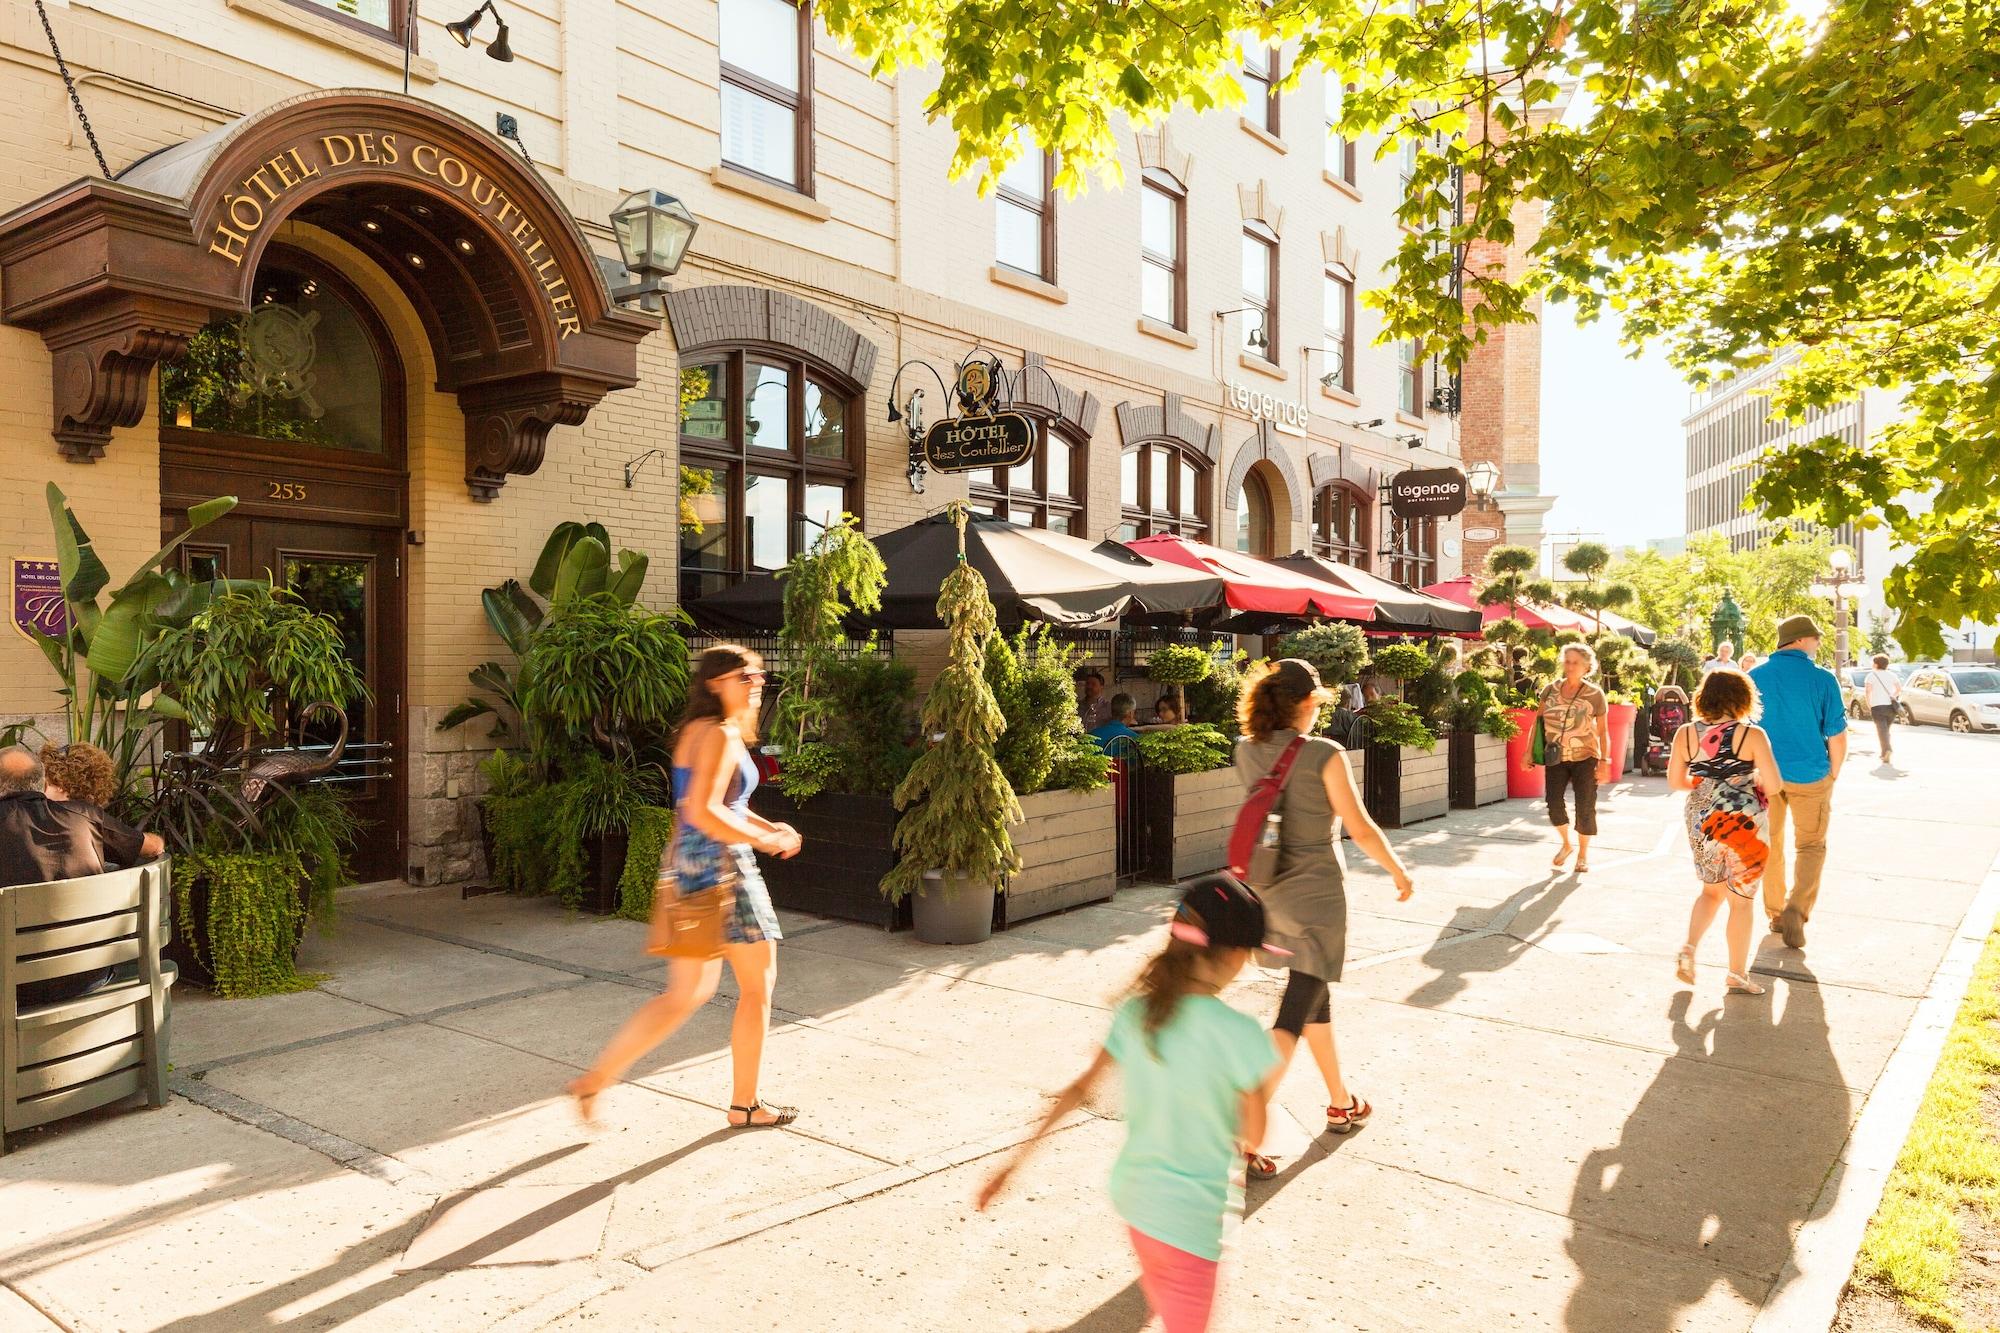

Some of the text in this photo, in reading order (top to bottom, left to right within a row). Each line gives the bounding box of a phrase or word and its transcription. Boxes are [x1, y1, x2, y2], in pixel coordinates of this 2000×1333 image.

[208, 132, 581, 341] HÔTEL DES COUTELLIER
[945, 424, 1009, 444] HÔTEL
[932, 438, 1025, 461] des Coutellier
[269, 481, 306, 500] 253
